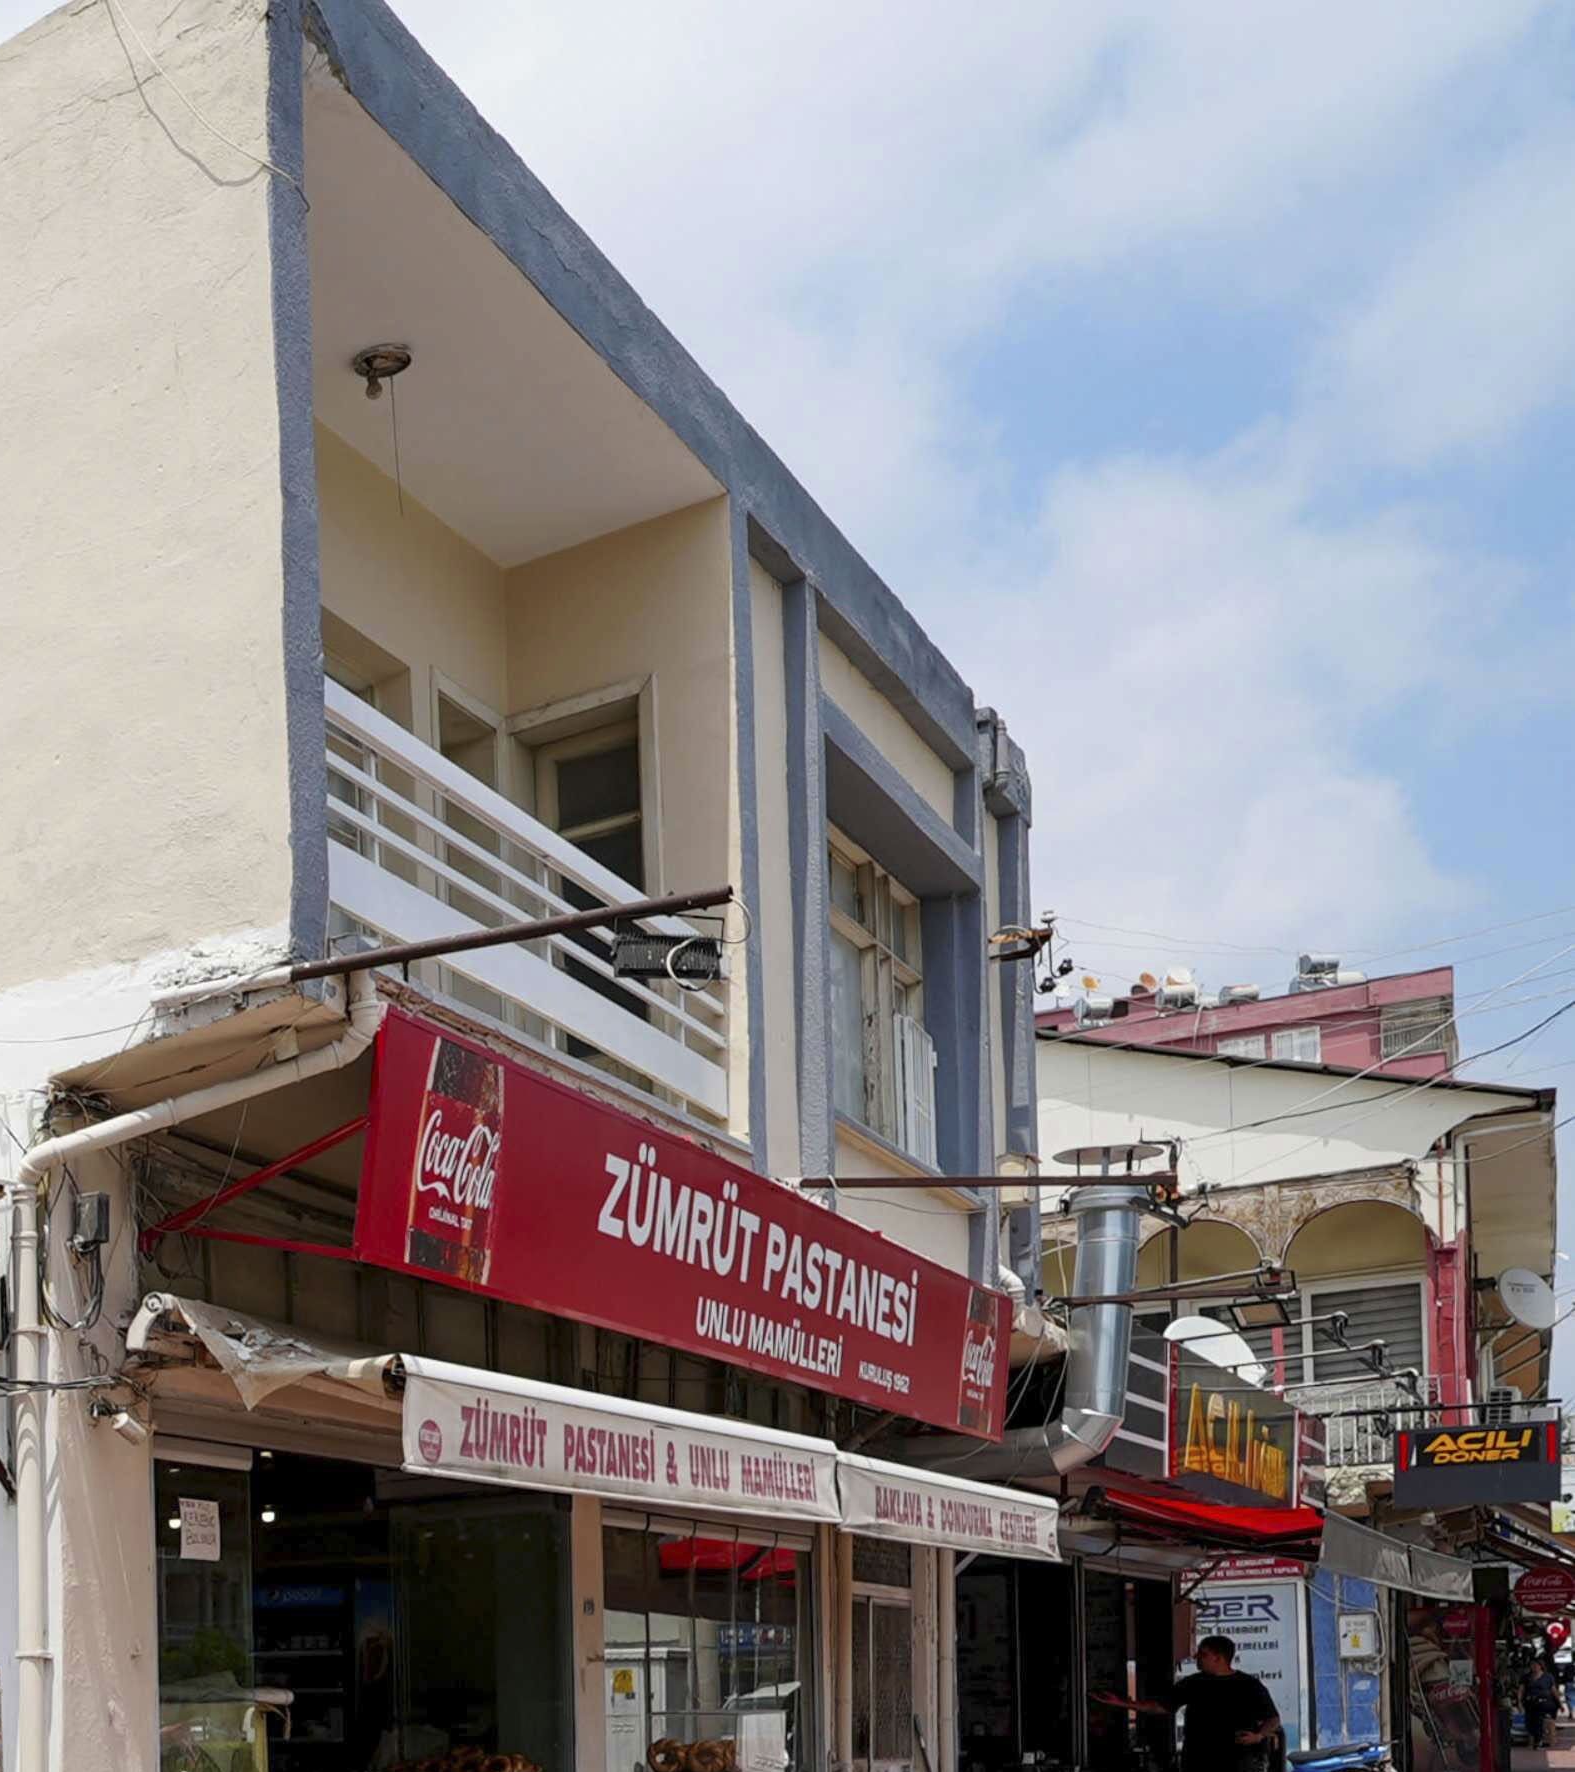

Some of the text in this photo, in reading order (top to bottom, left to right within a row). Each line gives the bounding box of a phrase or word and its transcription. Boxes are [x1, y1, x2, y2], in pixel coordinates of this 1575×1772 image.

[417, 1109, 501, 1210] Coca-Cola
[597, 1142, 918, 1347] ZÜMRÜT PASTANESİ
[696, 1296, 843, 1378] UNLU MAMÜLLERİ
[459, 1397, 548, 1469] ZÜMRÜT
[564, 1423, 656, 1484] PASTANESİ
[666, 1441, 679, 1486] &
[688, 1443, 730, 1492] UNLU
[741, 1451, 818, 1504] MAMÜLLERİ
[1423, 1428, 1533, 1453] ACILI
[875, 1485, 923, 1528] BAKLAVA
[927, 1495, 936, 1529] &
[940, 1498, 994, 1538] DONDURMA
